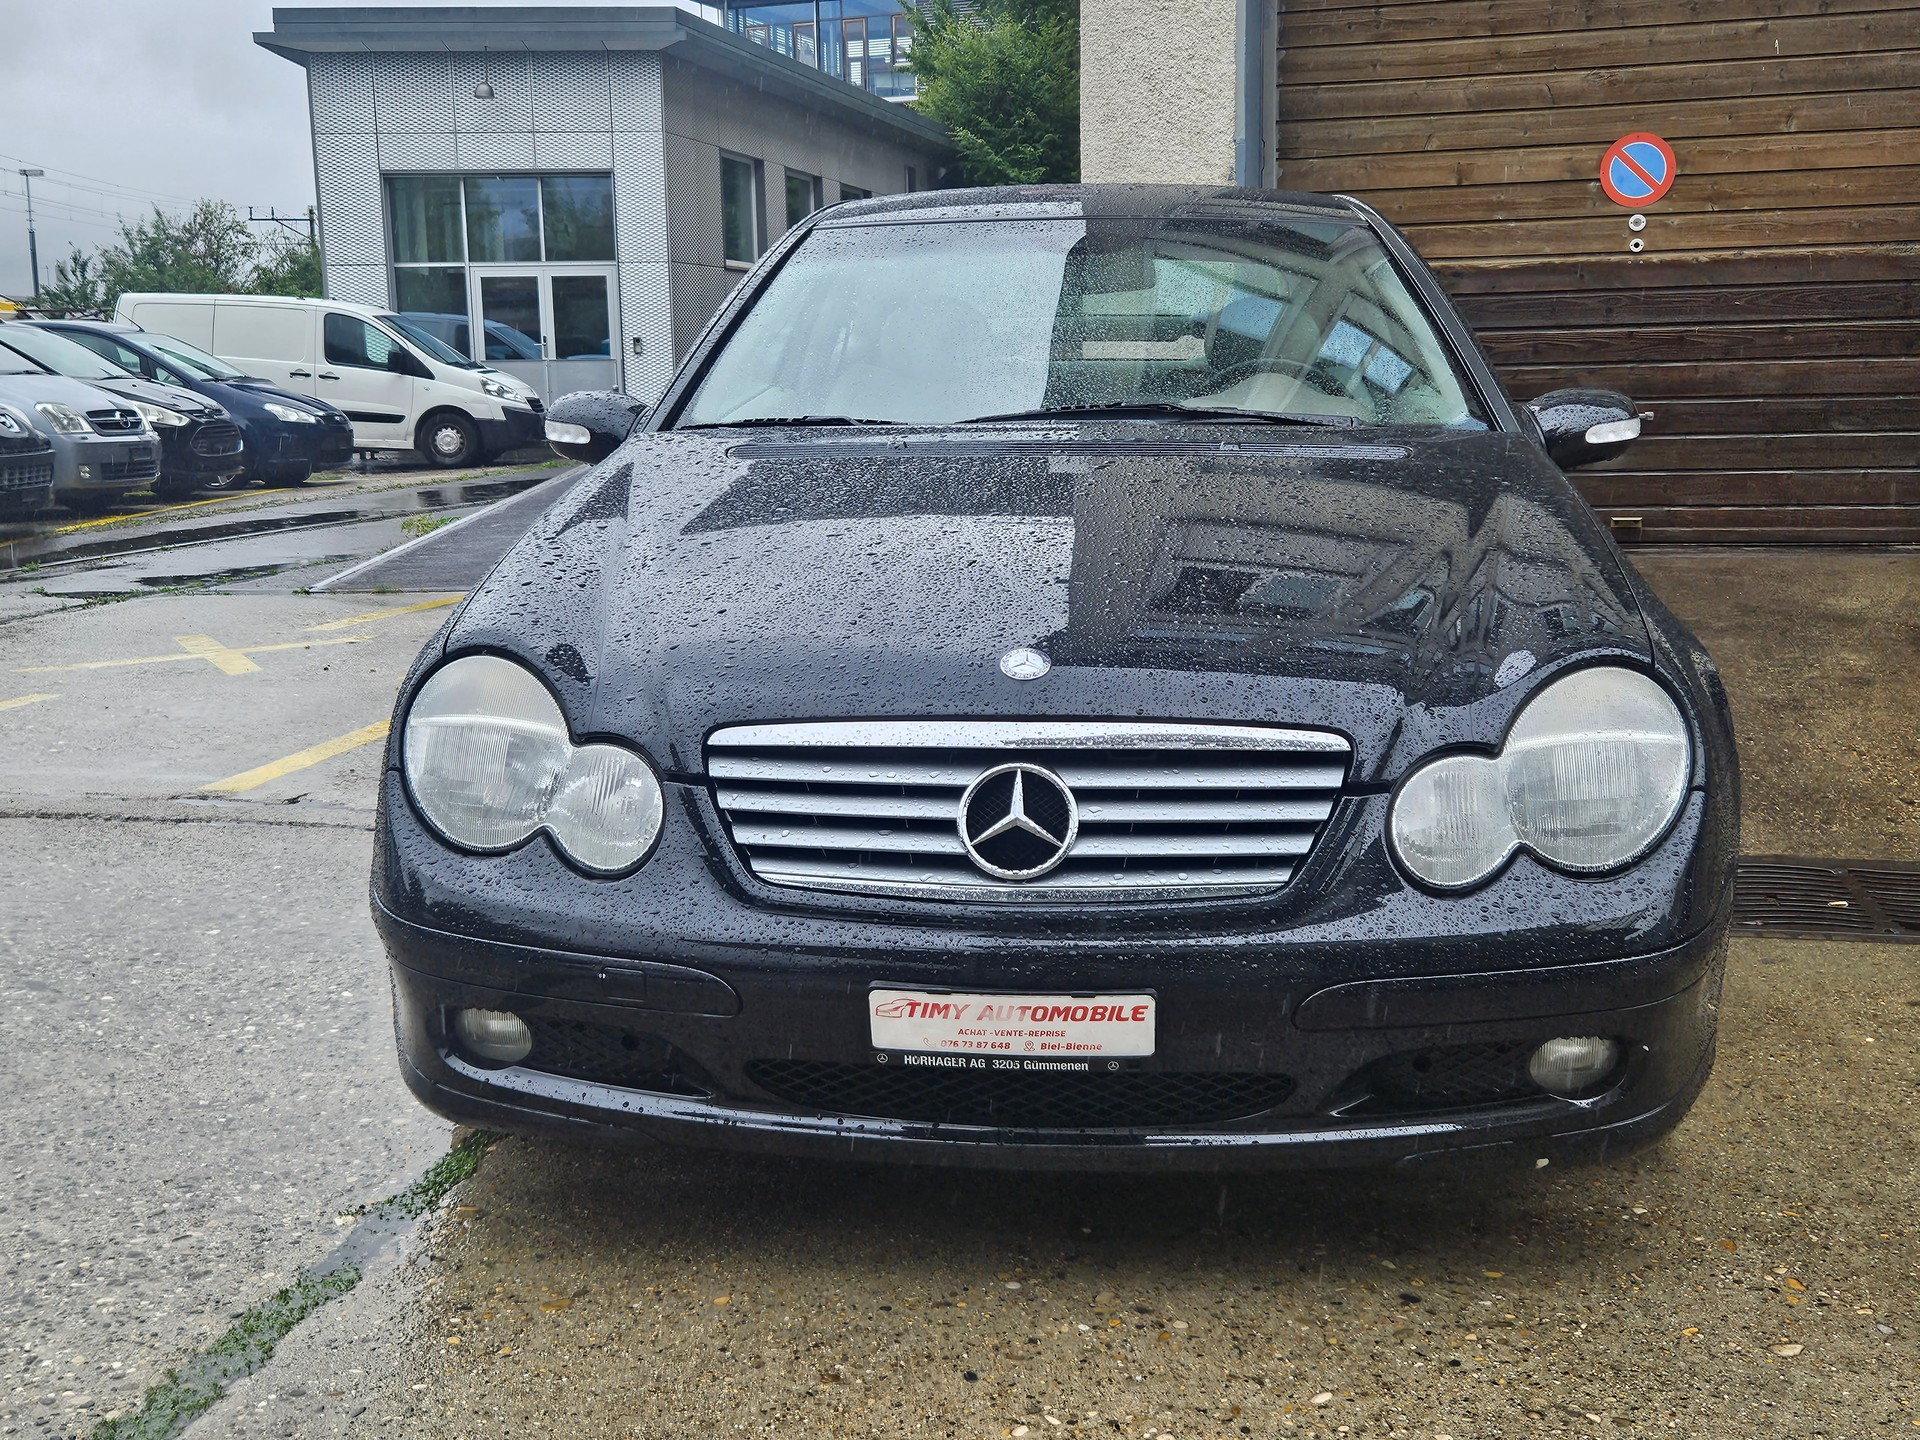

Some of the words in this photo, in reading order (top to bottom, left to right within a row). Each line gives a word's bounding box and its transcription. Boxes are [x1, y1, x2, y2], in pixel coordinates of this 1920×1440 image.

[907, 1002, 971, 1020] TIMY
[976, 1005, 1150, 1022] AUTOMOBILE
[957, 1028, 987, 1037] ACHAT
[940, 1040, 959, 1048] 076
[975, 1041, 988, 1049] 87
[990, 1042, 1011, 1050] 648
[1040, 1042, 1103, 1051] Biel-Bienne
[969, 1058, 986, 1068] AG
[992, 1059, 1020, 1070] 3205
[1023, 1060, 1089, 1071] Gümmenen
